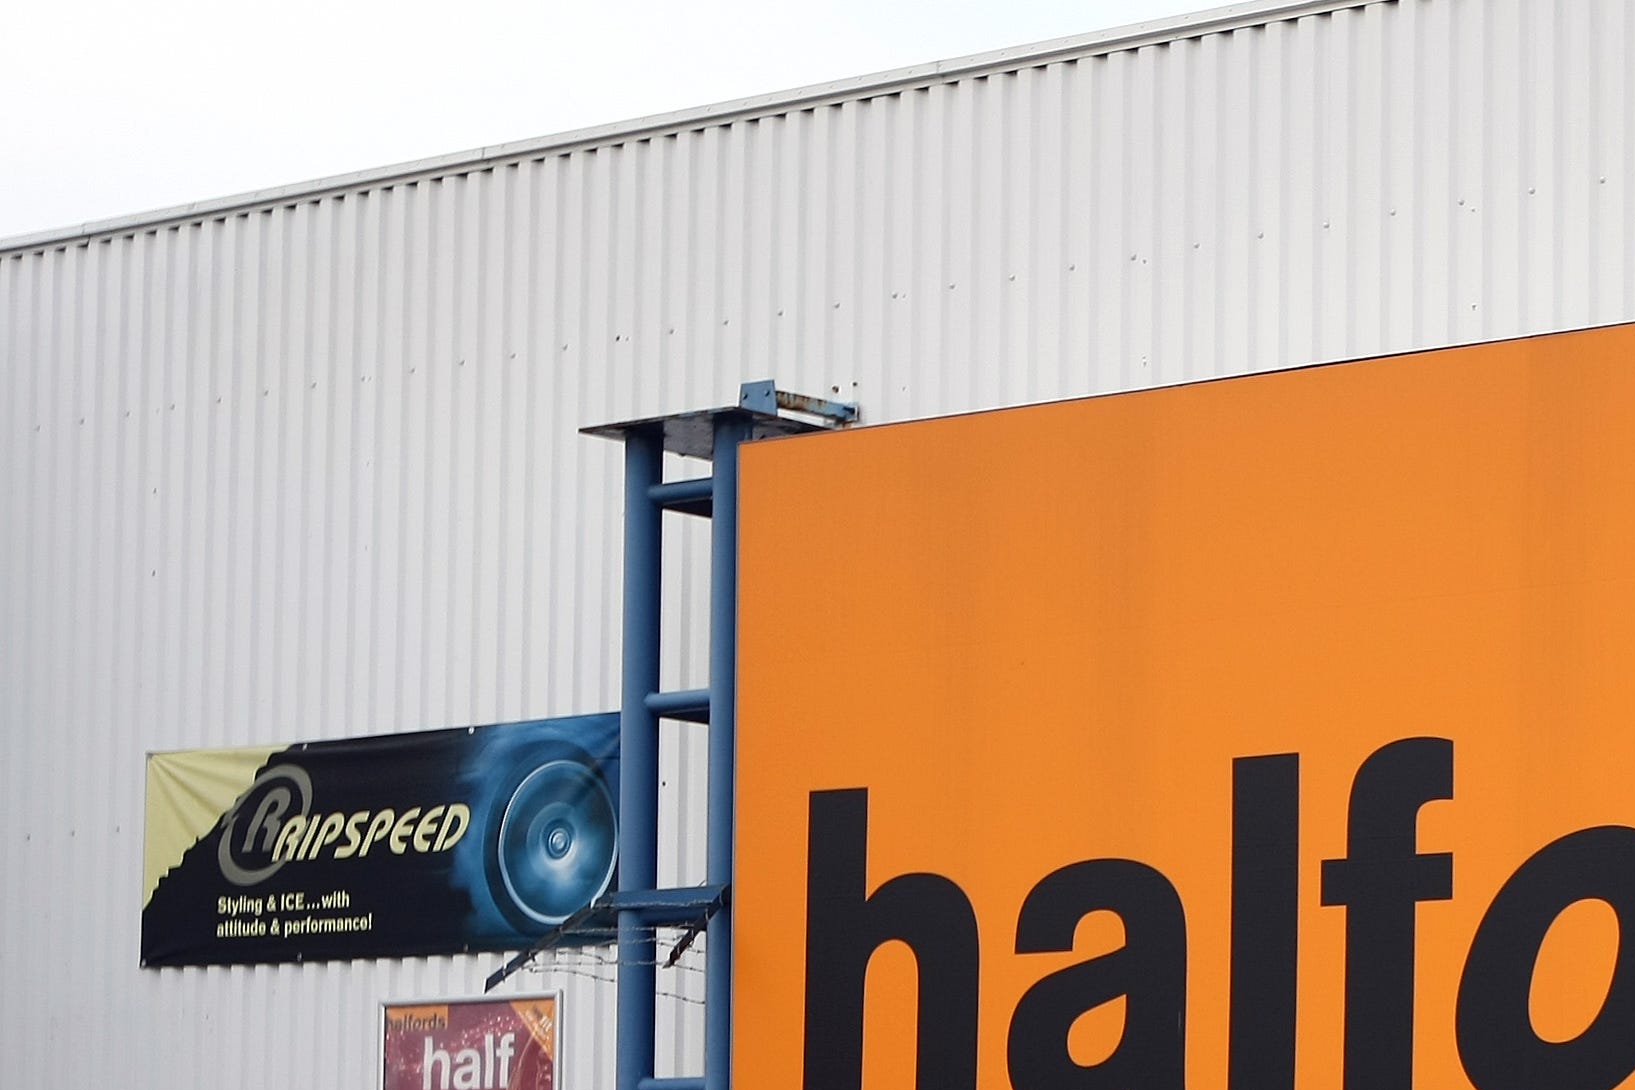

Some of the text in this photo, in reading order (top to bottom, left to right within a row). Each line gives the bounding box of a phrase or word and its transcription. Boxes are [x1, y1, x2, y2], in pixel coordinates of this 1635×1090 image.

[271, 803, 471, 862] RIPSPEED
[216, 913, 373, 938] attitude & performance!
[217, 895, 263, 916] Styling
[266, 894, 277, 912] &
[422, 1033, 515, 1090] half
